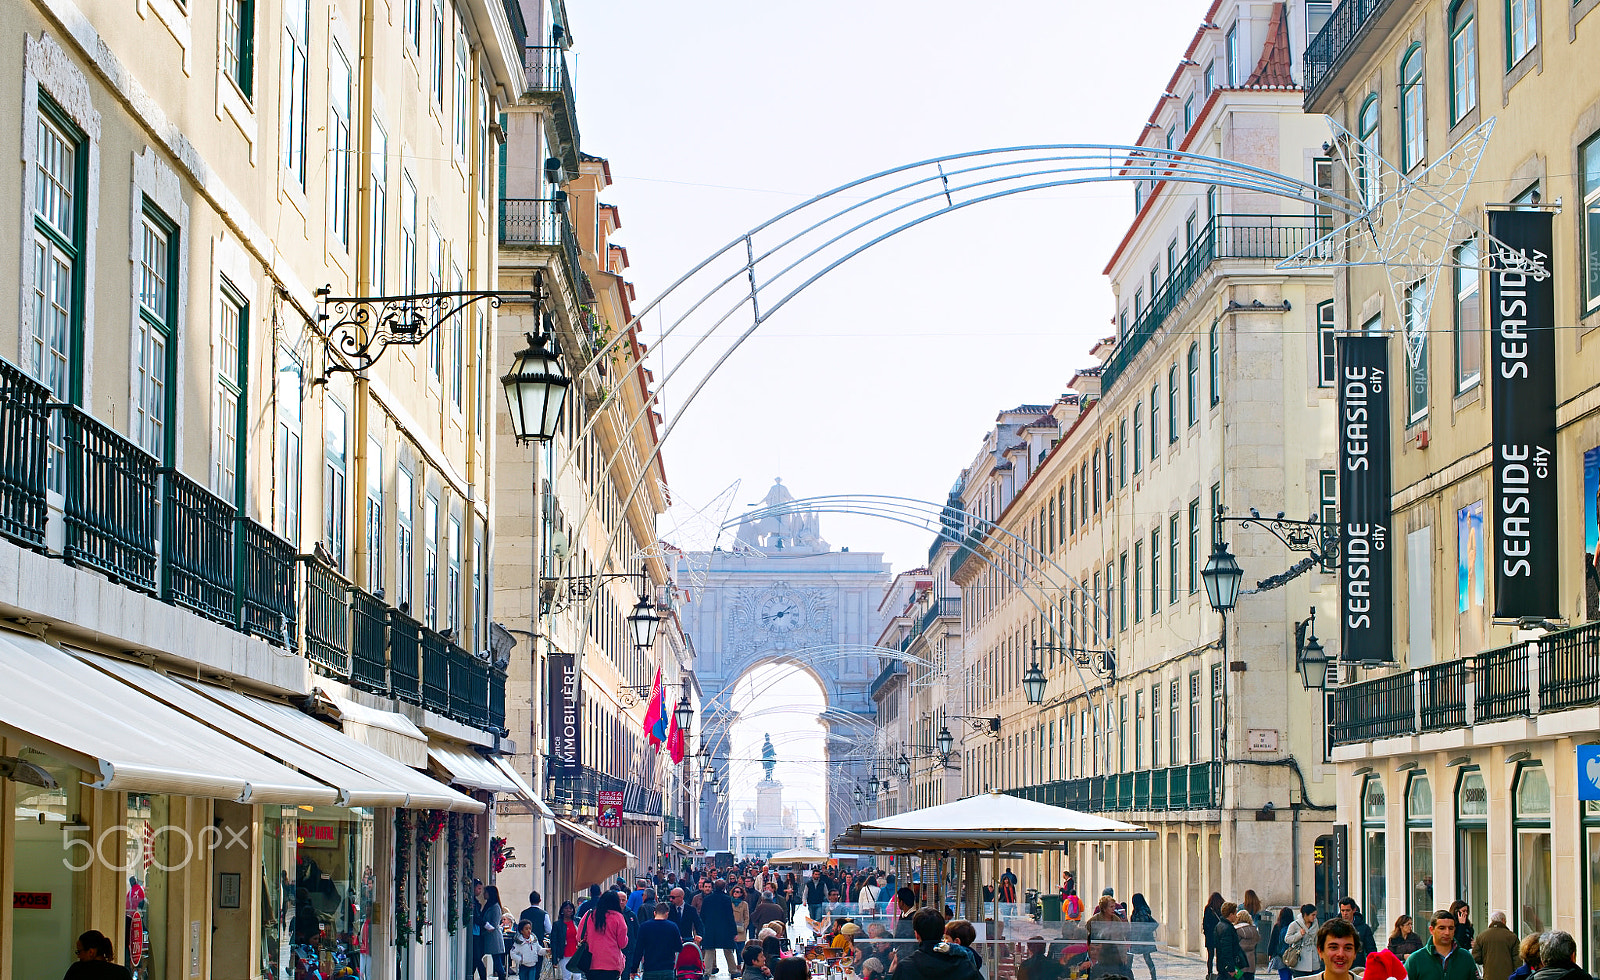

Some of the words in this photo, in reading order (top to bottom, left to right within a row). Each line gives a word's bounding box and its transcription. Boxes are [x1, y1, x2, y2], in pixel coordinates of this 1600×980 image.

[1500, 248, 1528, 379] SEASIDE
[1345, 366, 1369, 472] SEASIDE
[1369, 367, 1384, 394] city
[1502, 444, 1531, 577] SEASIDE
[1532, 445, 1551, 479] city
[1347, 523, 1371, 629] SEASIDE
[1372, 523, 1387, 551] city
[560, 665, 576, 767] IMMOBILIÈRE
